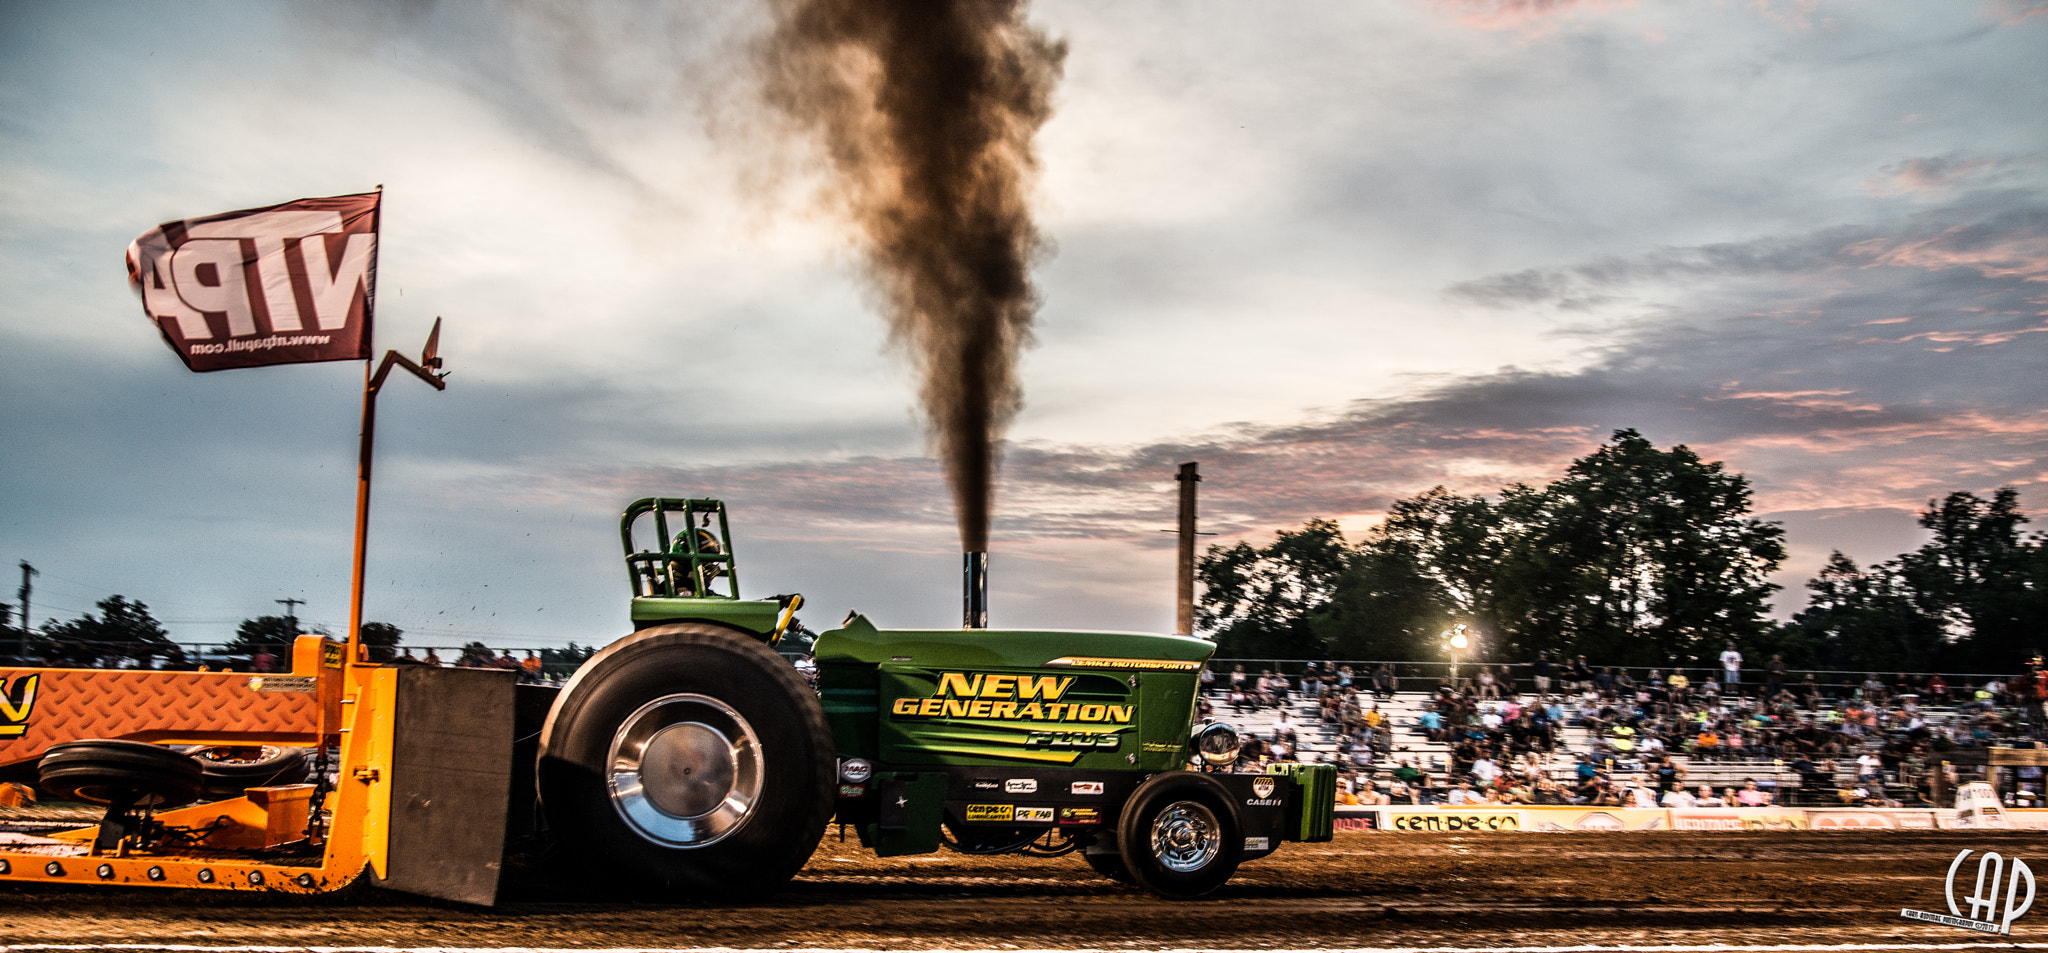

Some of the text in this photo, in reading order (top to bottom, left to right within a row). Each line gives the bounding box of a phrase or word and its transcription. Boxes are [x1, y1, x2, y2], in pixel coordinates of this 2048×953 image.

[935, 672, 1073, 700] NEW
[891, 697, 1136, 723] GENERATION
[1025, 731, 1122, 748] PLUS
[1246, 798, 1272, 806] CASE
